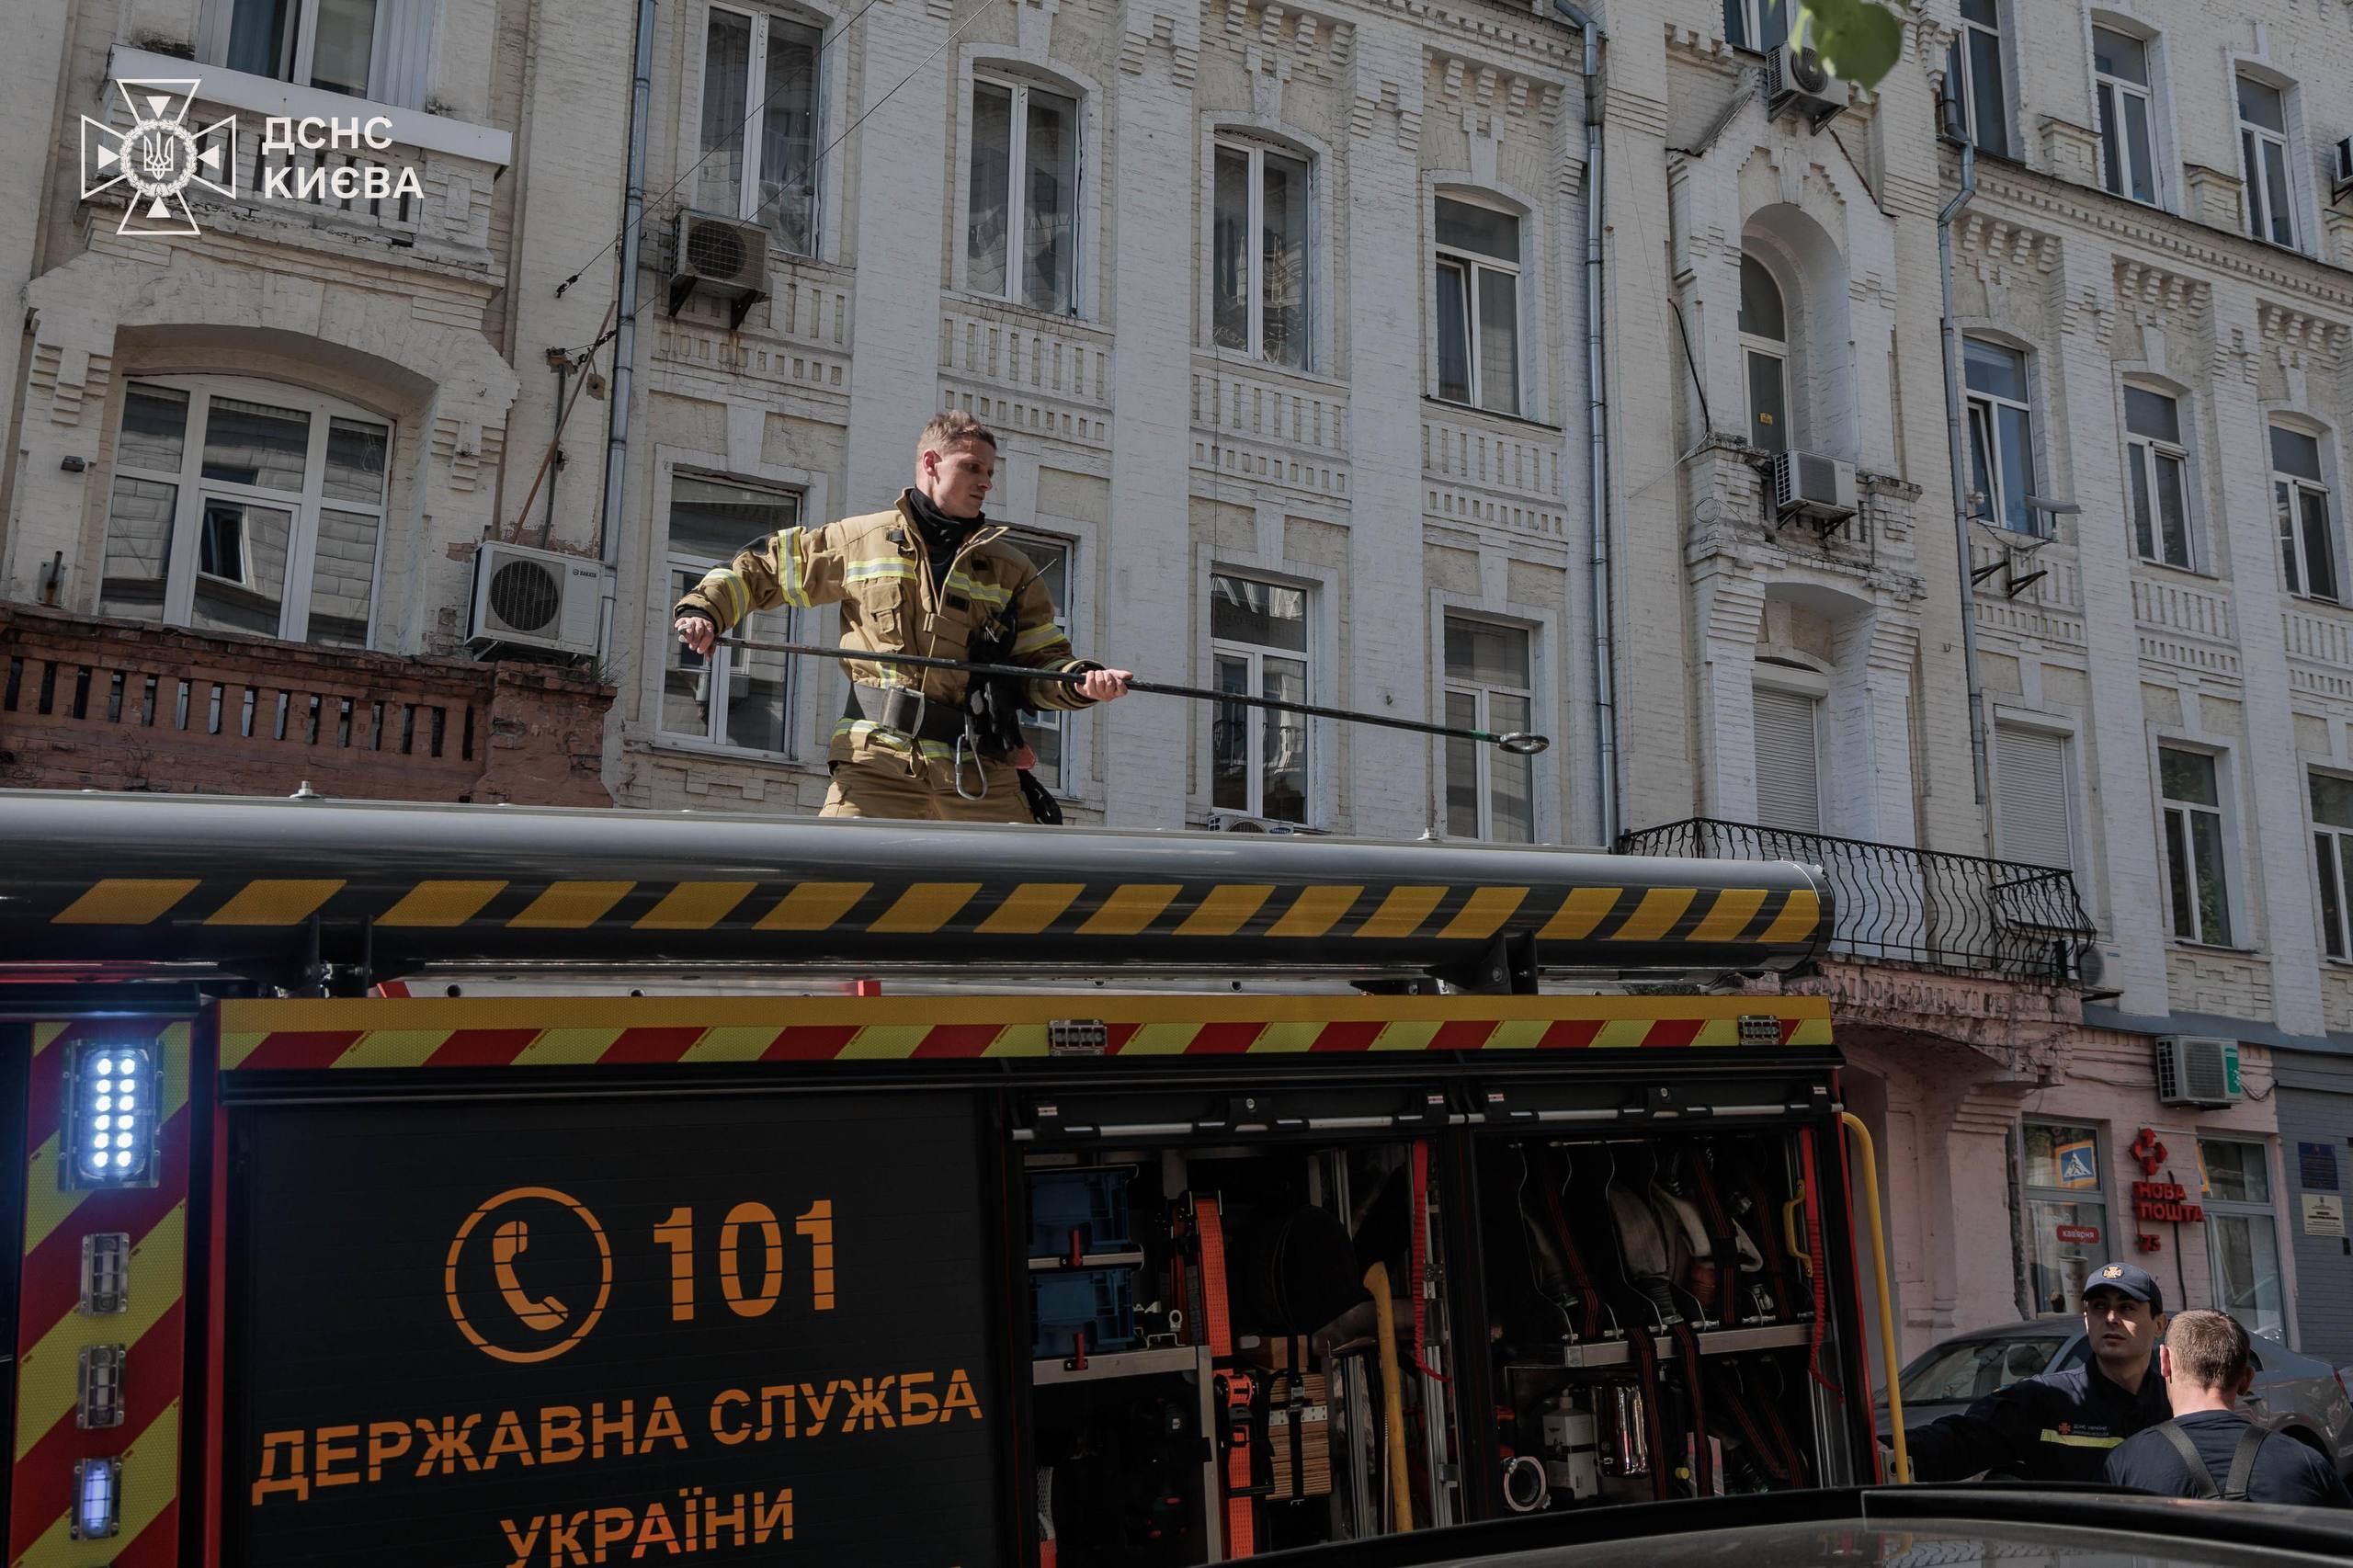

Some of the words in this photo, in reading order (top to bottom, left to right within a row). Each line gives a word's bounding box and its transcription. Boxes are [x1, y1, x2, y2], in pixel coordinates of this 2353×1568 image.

[2133, 1182, 2187, 1200] НОВА
[2138, 1201, 2206, 1222] ПОШТА
[654, 1200, 834, 1321] 101
[252, 1397, 688, 1505] ДЕРЖАВНА
[710, 1369, 983, 1445] СЛУЖБА
[501, 1486, 793, 1568] УКРАЇНИ
